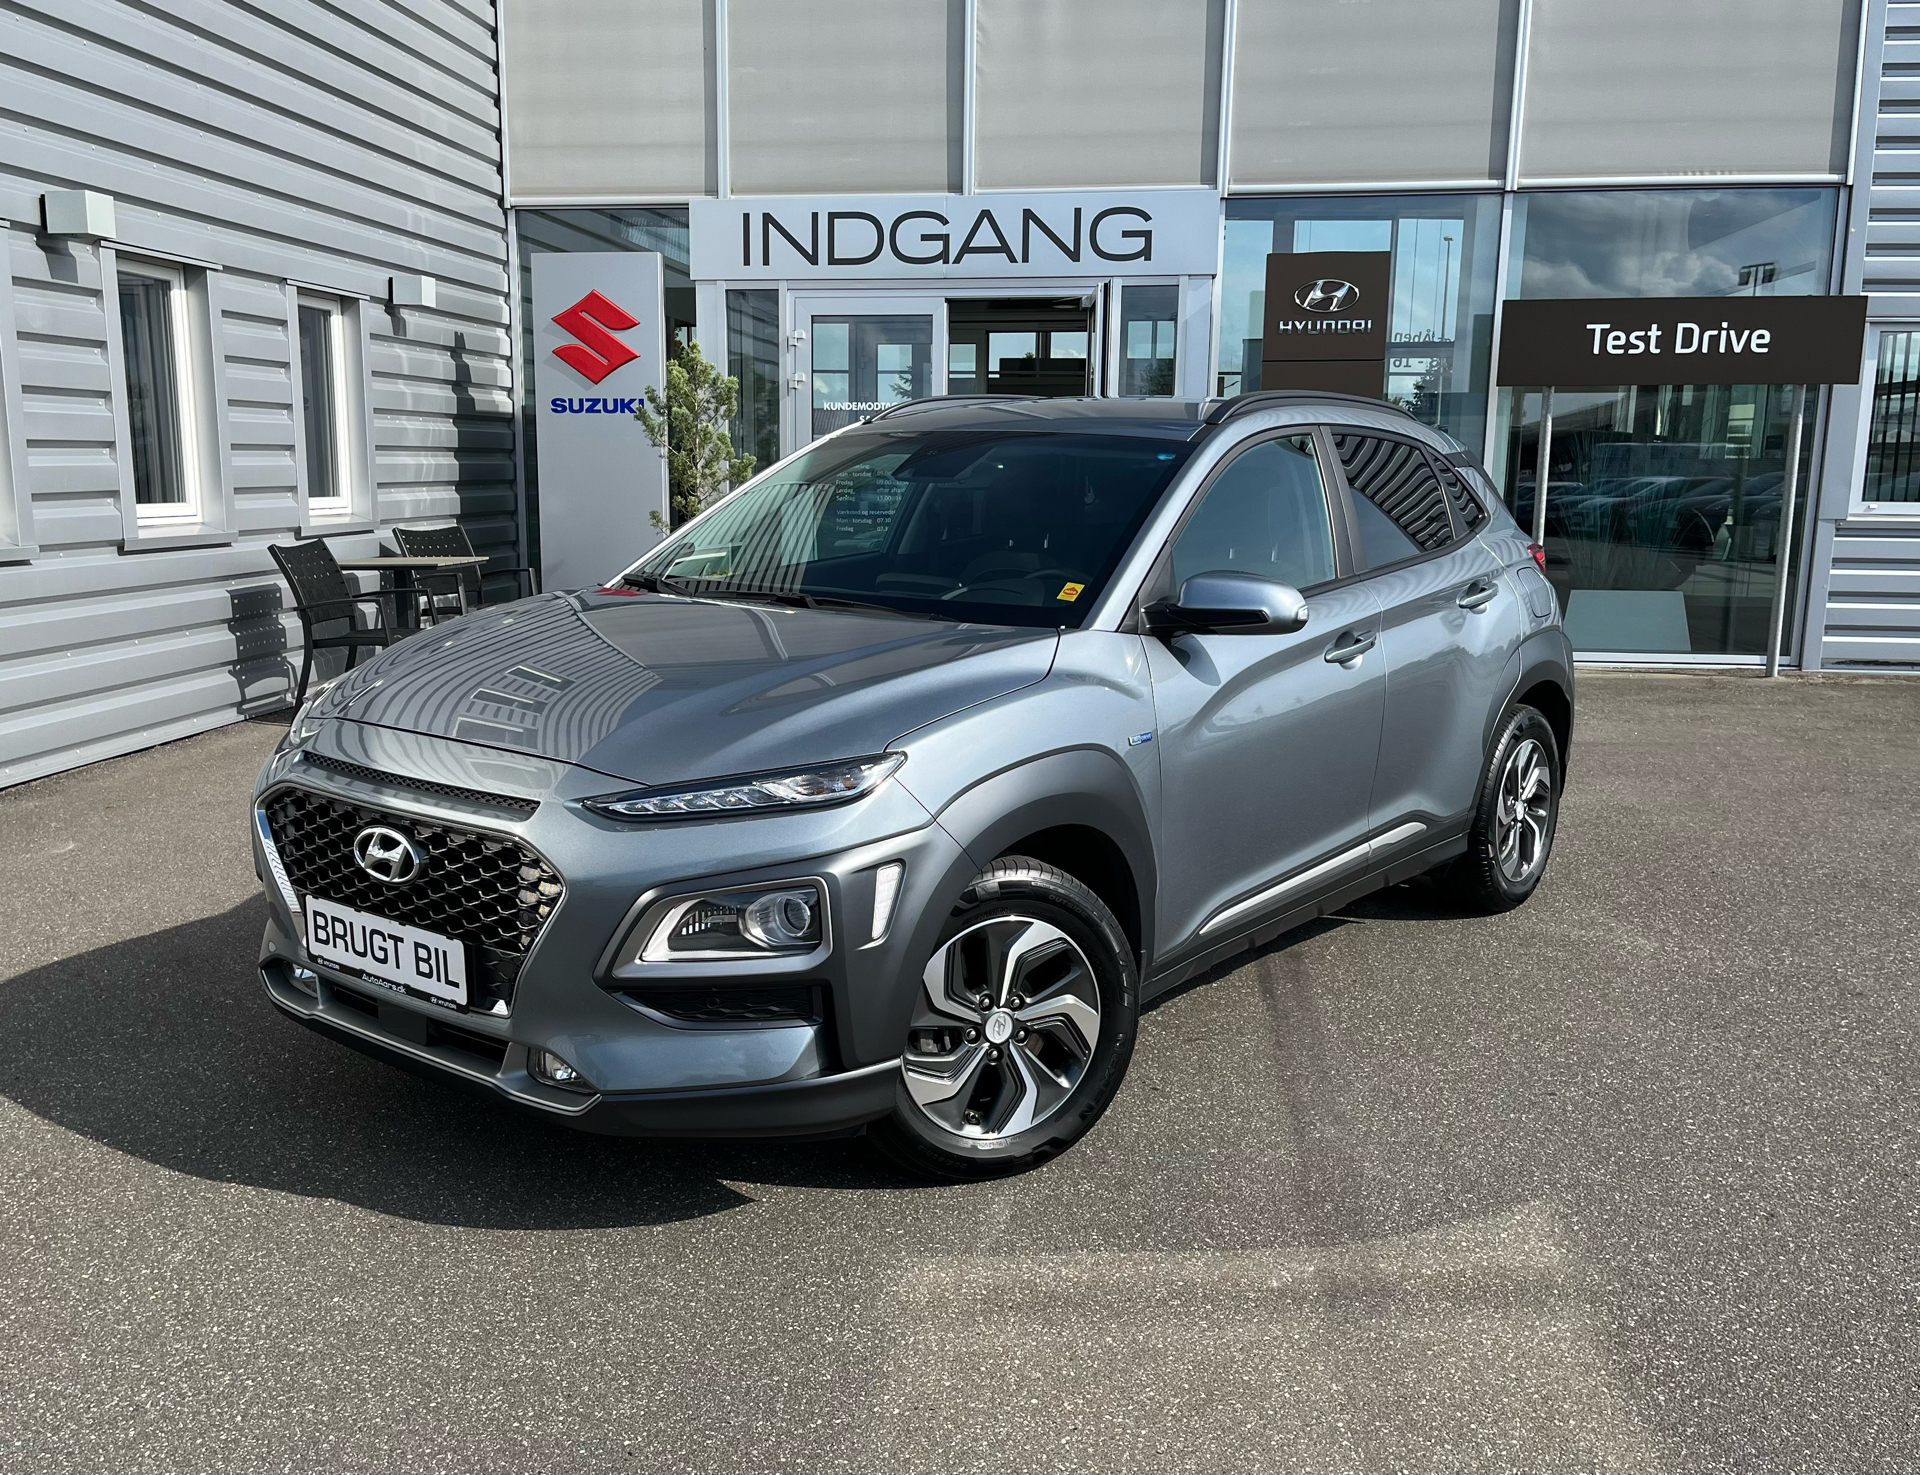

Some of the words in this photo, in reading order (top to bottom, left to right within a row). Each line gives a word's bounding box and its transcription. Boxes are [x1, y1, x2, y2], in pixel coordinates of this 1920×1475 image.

[742, 206, 1153, 267] INDGANG
[1279, 319, 1372, 335] HYUNDAI
[1586, 323, 1662, 355] Test
[1674, 321, 1771, 354] Drive
[312, 909, 405, 970] BRUGT
[413, 940, 460, 990] BIL
[1078, 1032, 1127, 1121] NEXEN
